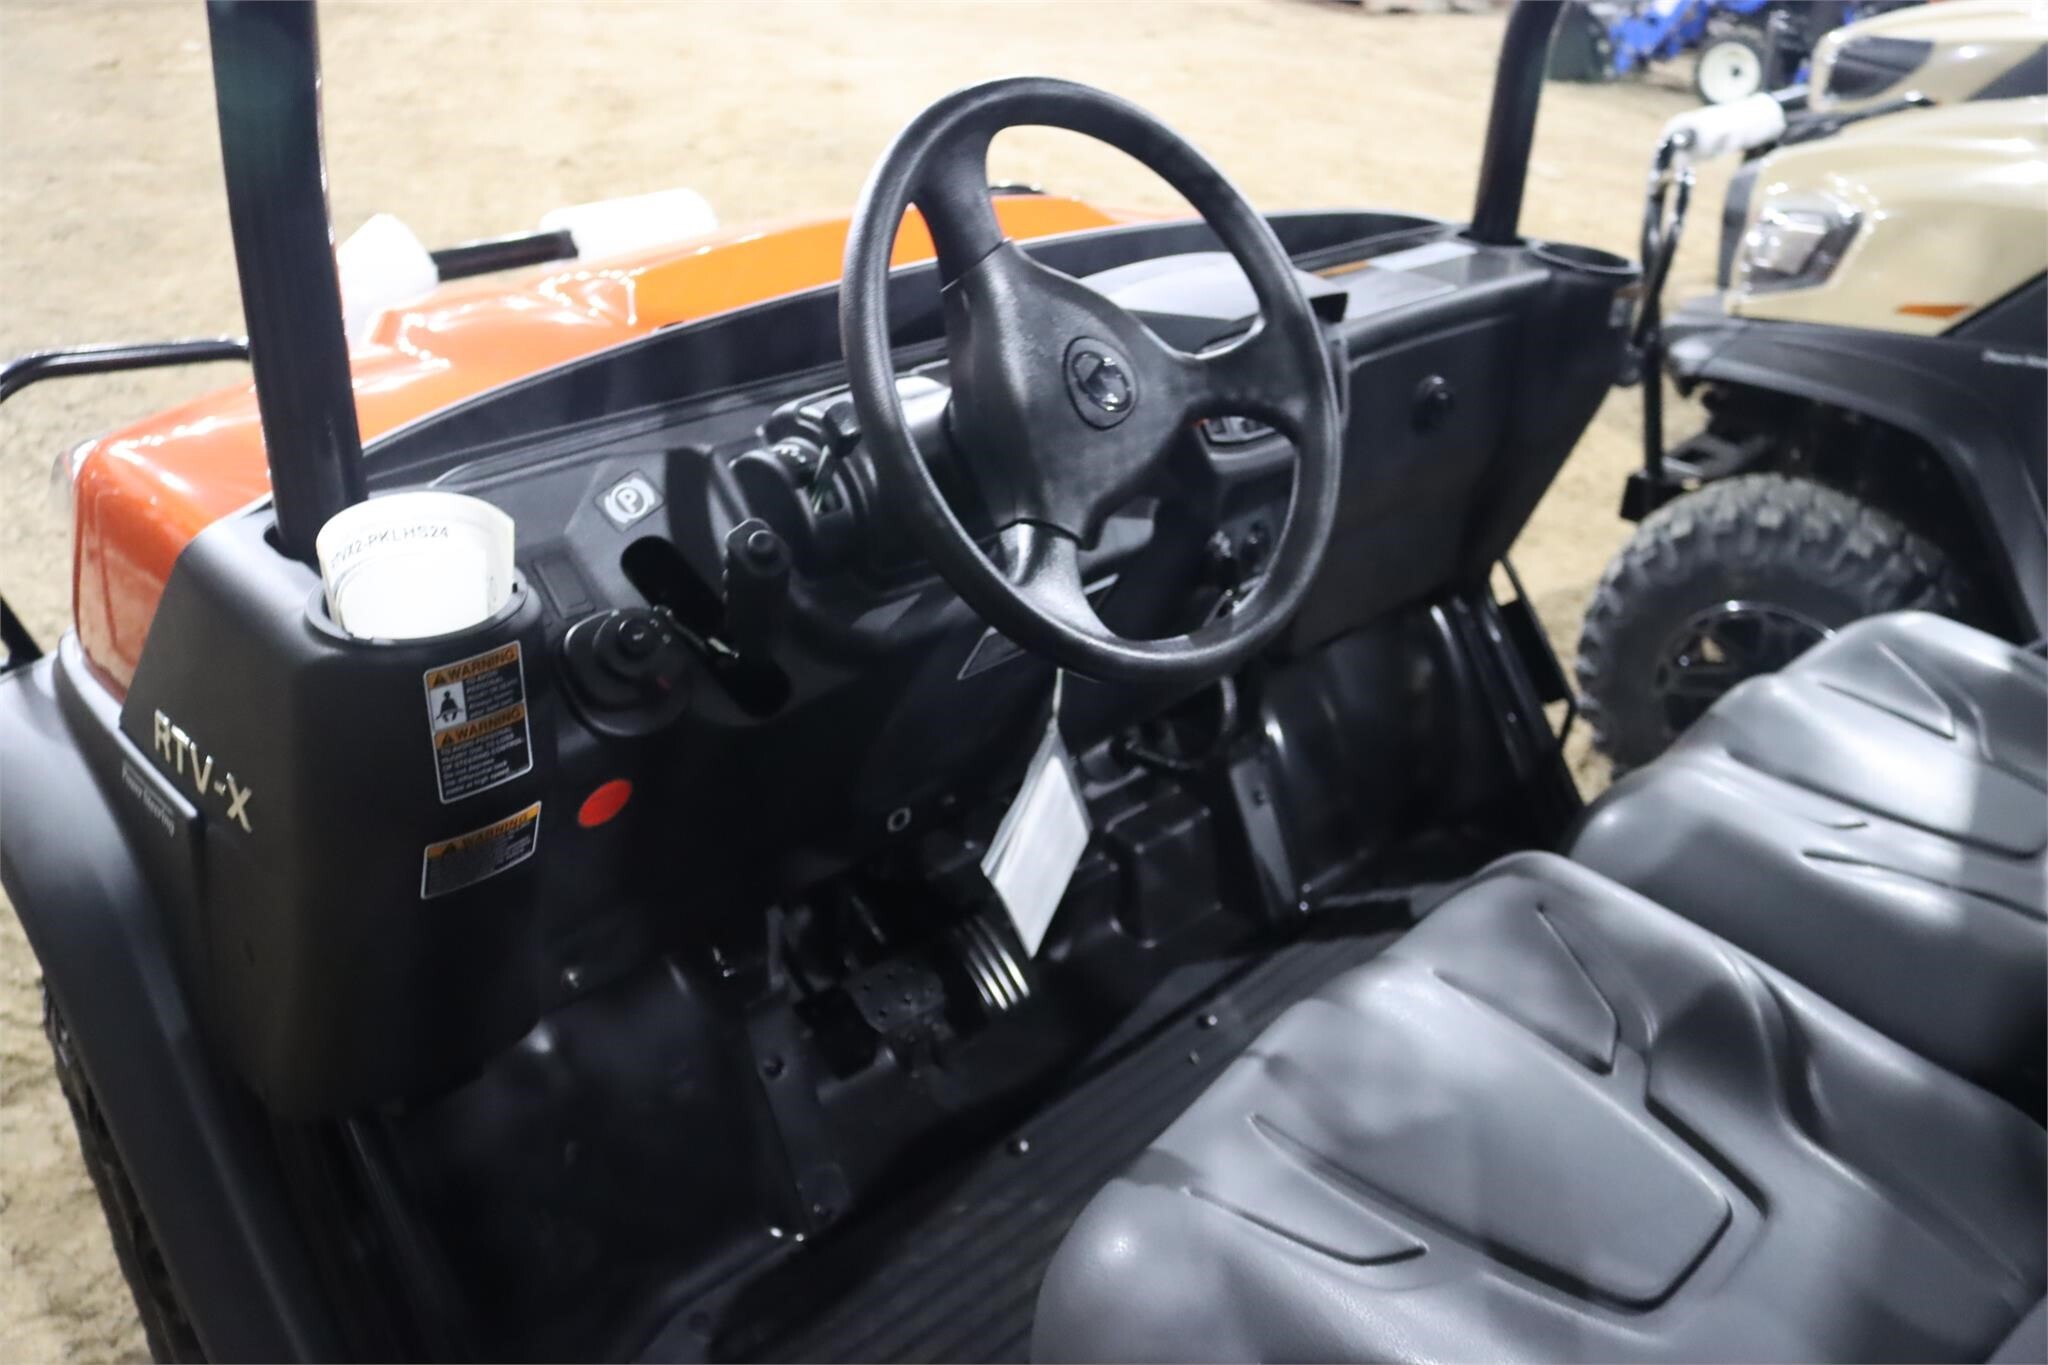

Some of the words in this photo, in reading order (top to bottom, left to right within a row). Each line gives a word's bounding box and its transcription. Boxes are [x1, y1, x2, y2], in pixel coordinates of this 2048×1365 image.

[449, 649, 516, 682] WARNING
[457, 706, 522, 742] WARNING
[154, 708, 252, 833] RTV-X
[463, 812, 529, 850] WARNING
